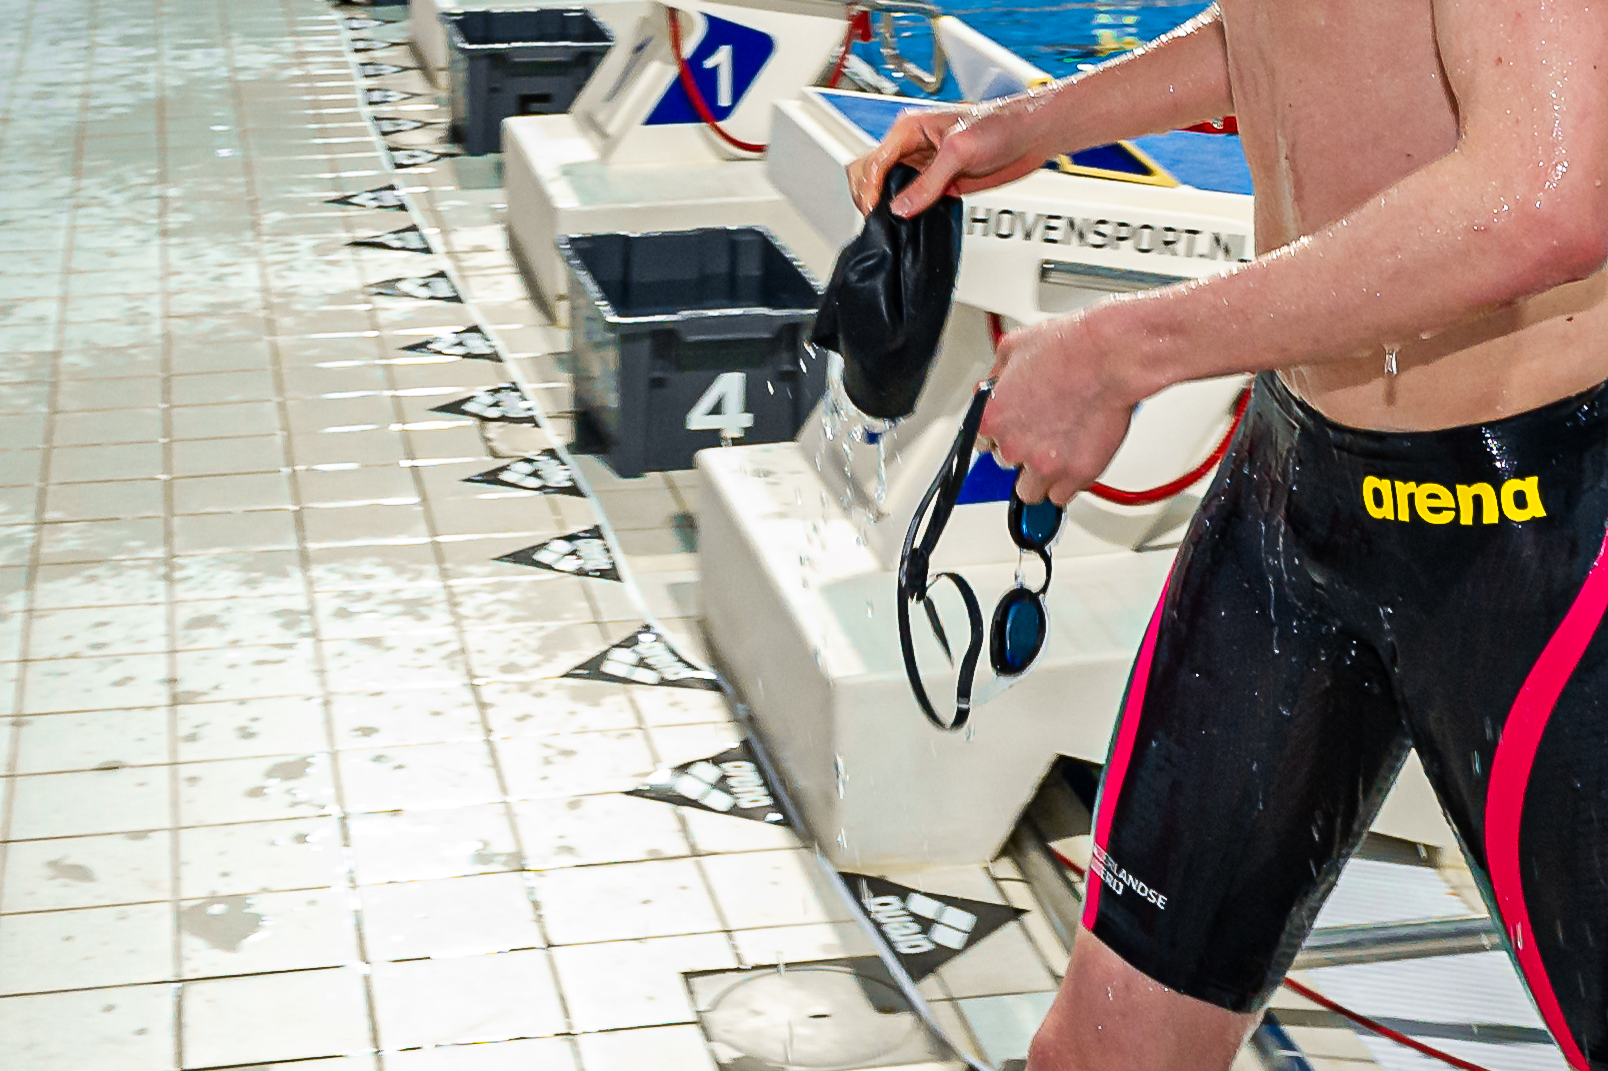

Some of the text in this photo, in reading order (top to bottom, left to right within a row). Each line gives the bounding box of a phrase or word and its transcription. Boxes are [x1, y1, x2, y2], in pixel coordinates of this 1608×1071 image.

[702, 44, 735, 107] 1
[685, 371, 754, 439] 4
[1362, 475, 1547, 526] arena
